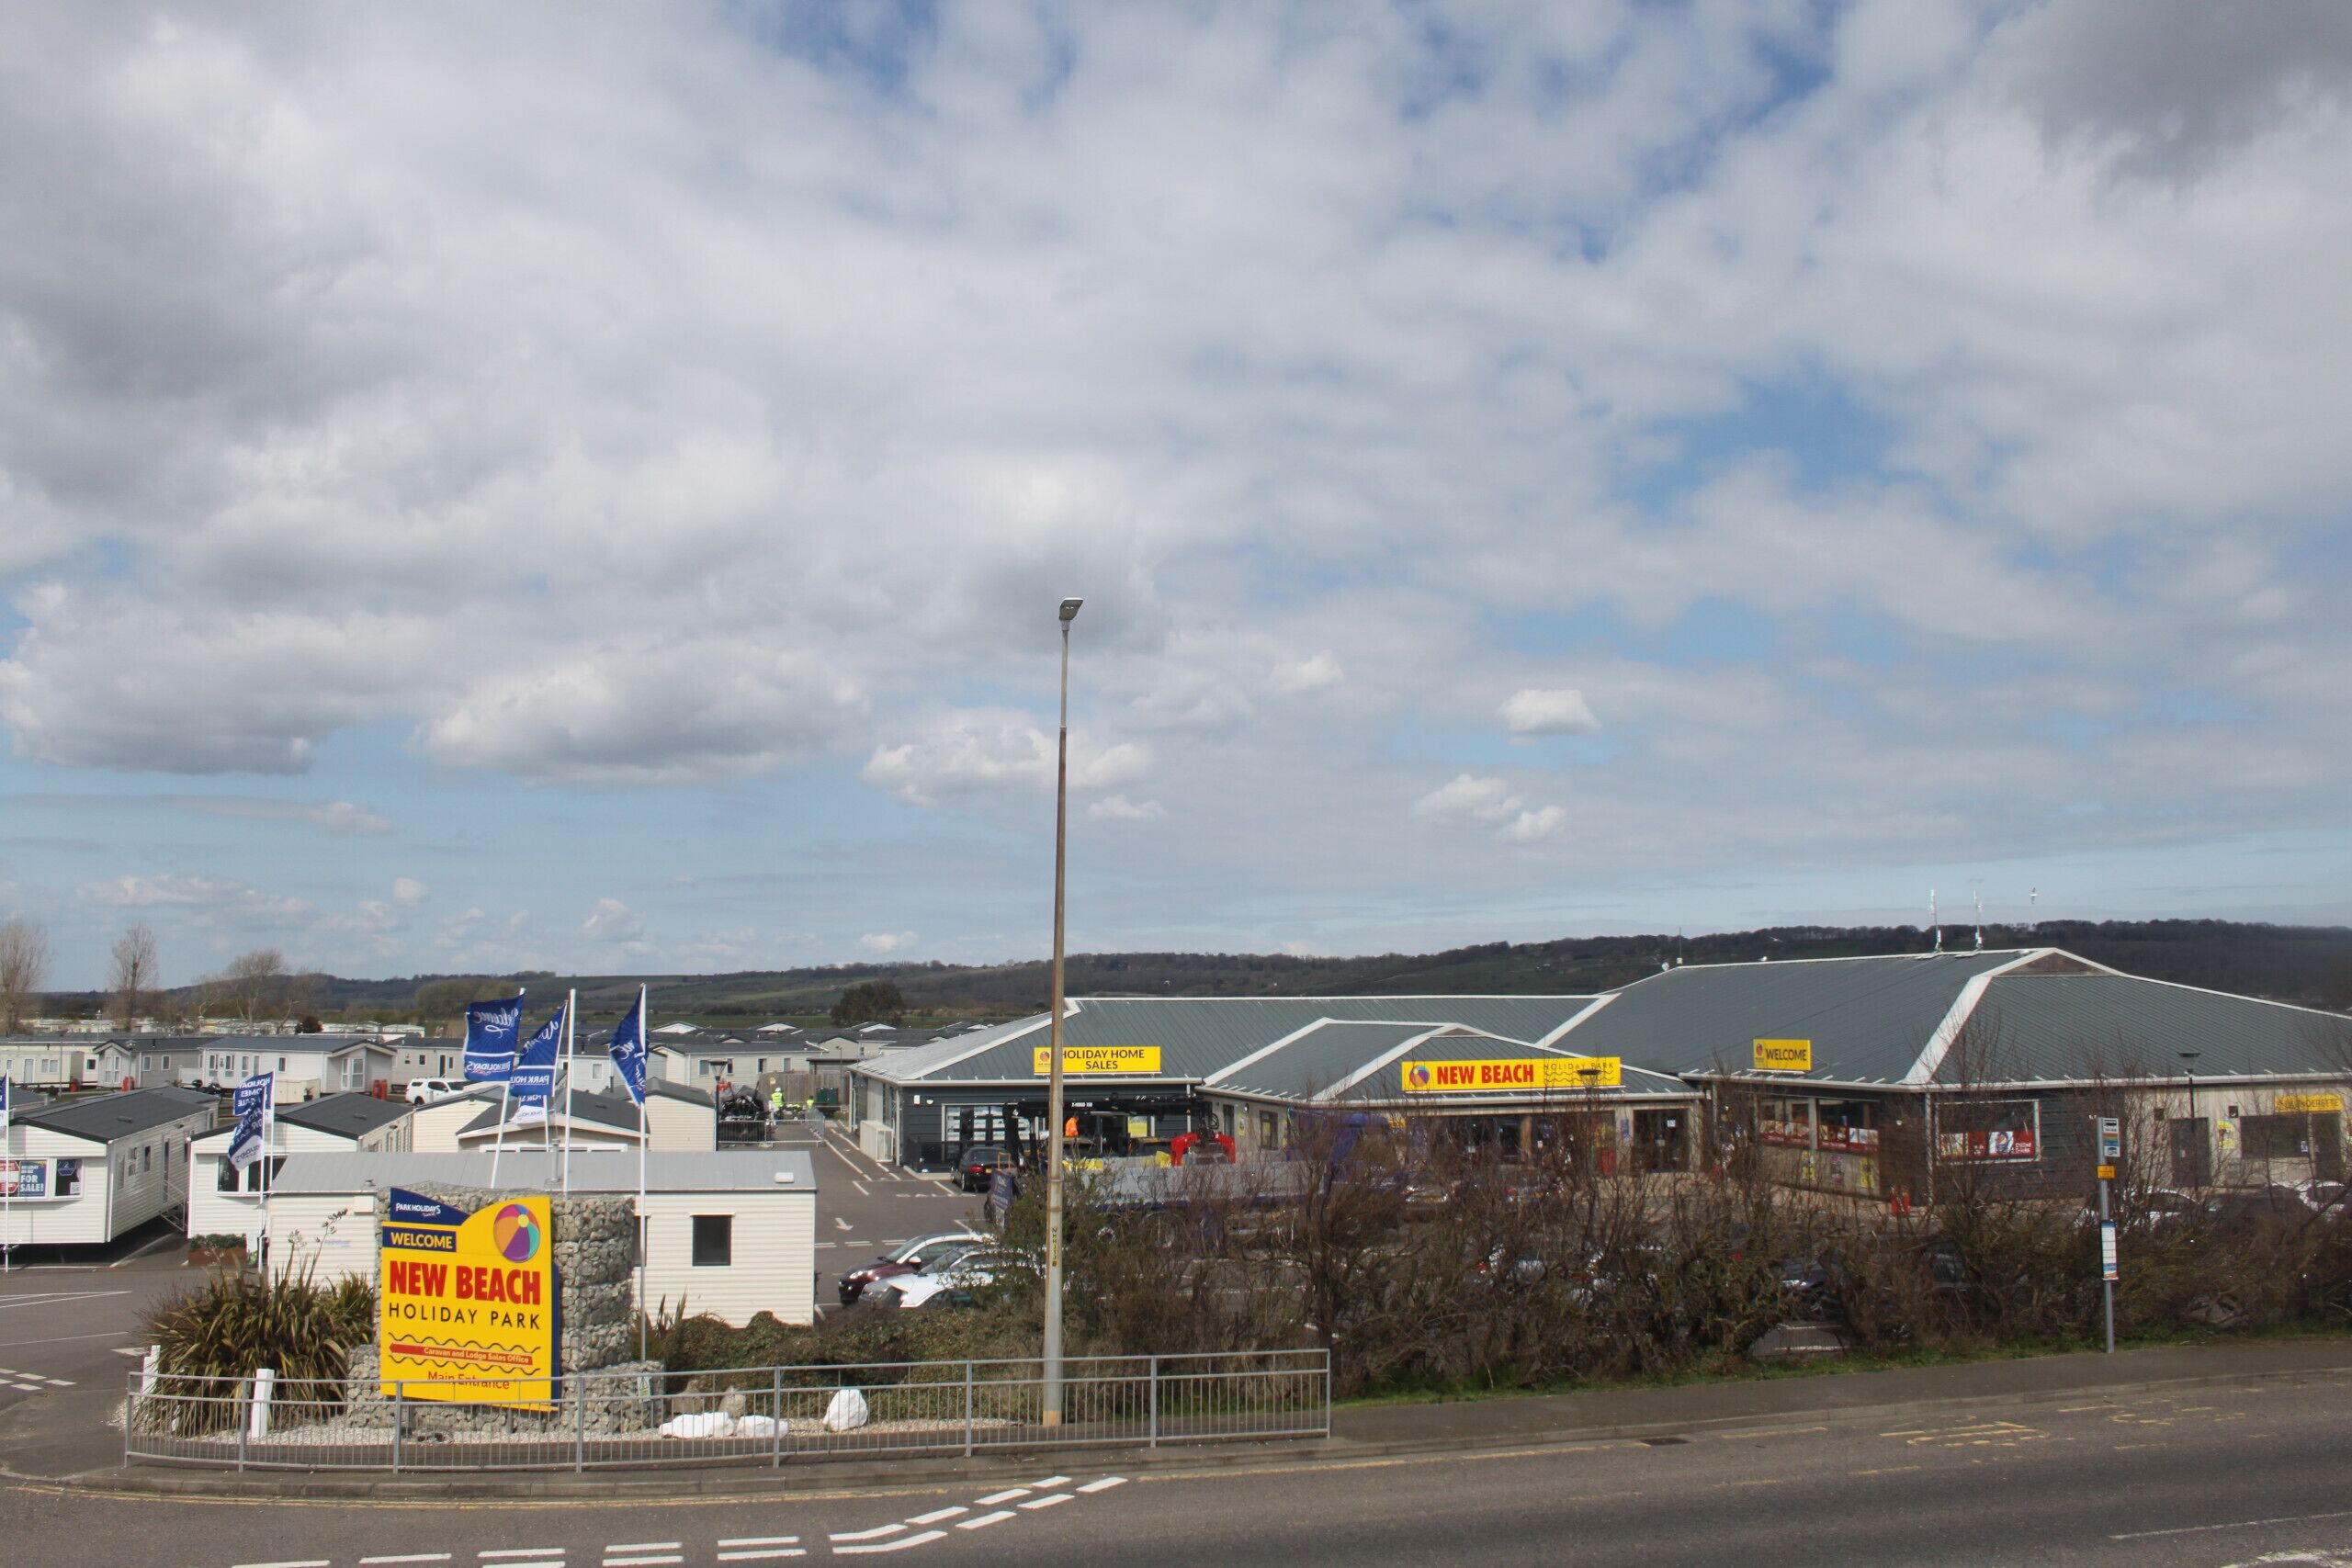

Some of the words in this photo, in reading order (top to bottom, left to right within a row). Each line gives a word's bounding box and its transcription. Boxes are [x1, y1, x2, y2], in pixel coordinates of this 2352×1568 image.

[1111, 1049, 1145, 1058] HOME
[1765, 1049, 1807, 1061] WELCOME
[1086, 1060, 1118, 1069] SALES
[1437, 1066, 1475, 1085] NEW
[1481, 1064, 1534, 1084] BEACH
[20, 1175, 39, 1183] FOR
[20, 1183, 44, 1192] SALE!
[395, 1202, 412, 1212] PARK
[412, 1204, 441, 1214] HOLIDAYS
[390, 1231, 453, 1249] WELCOME
[390, 1260, 447, 1297] NEW
[456, 1265, 540, 1304] BEACH
[389, 1303, 478, 1325] HOLIDAY
[491, 1311, 540, 1330] PARK
[424, 1347, 451, 1357] Caravan
[452, 1348, 464, 1358] and
[466, 1350, 487, 1361] Lodge
[488, 1352, 506, 1361] Sales
[507, 1354, 529, 1364] Office
